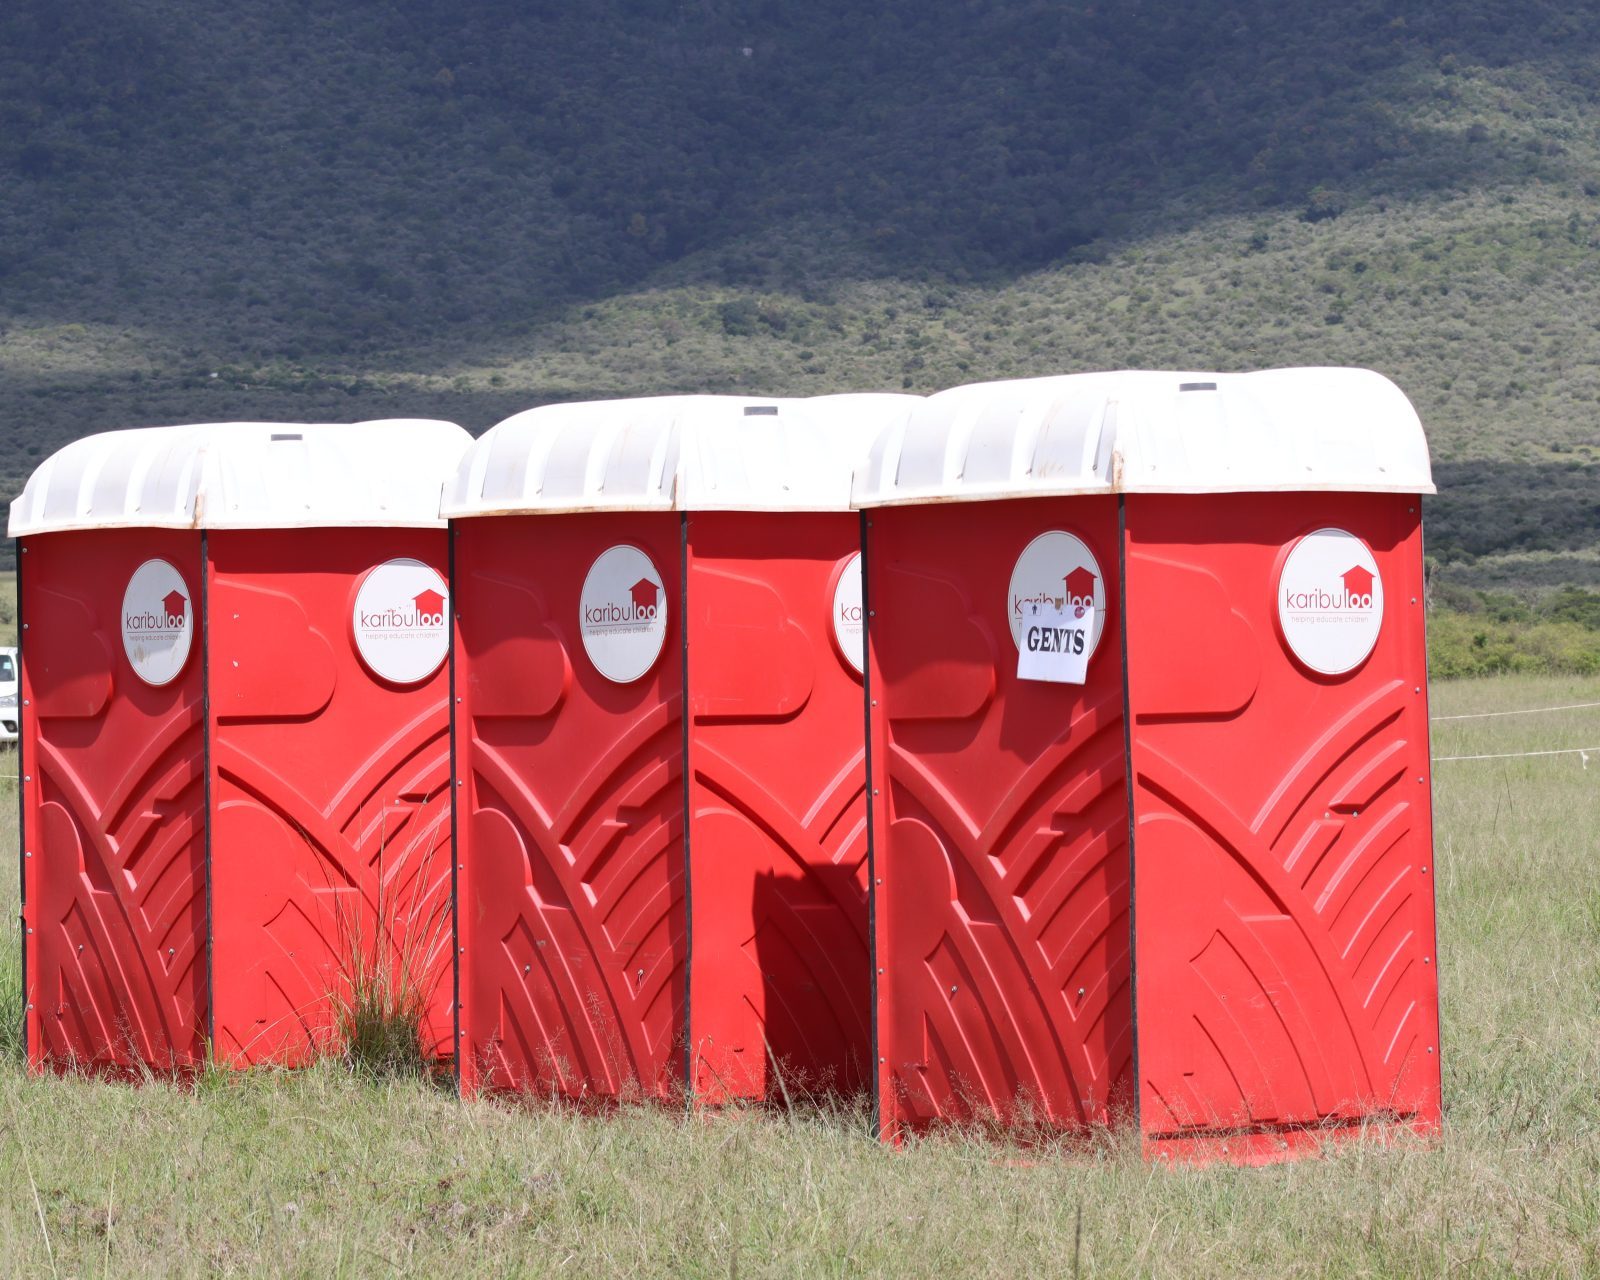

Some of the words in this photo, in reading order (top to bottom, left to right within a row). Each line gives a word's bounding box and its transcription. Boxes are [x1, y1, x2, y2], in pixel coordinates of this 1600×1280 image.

[1014, 591, 1094, 614] kibloo
[1291, 616, 1315, 624] helping
[589, 628, 608, 637] helping
[1027, 626, 1085, 655] GENTS
